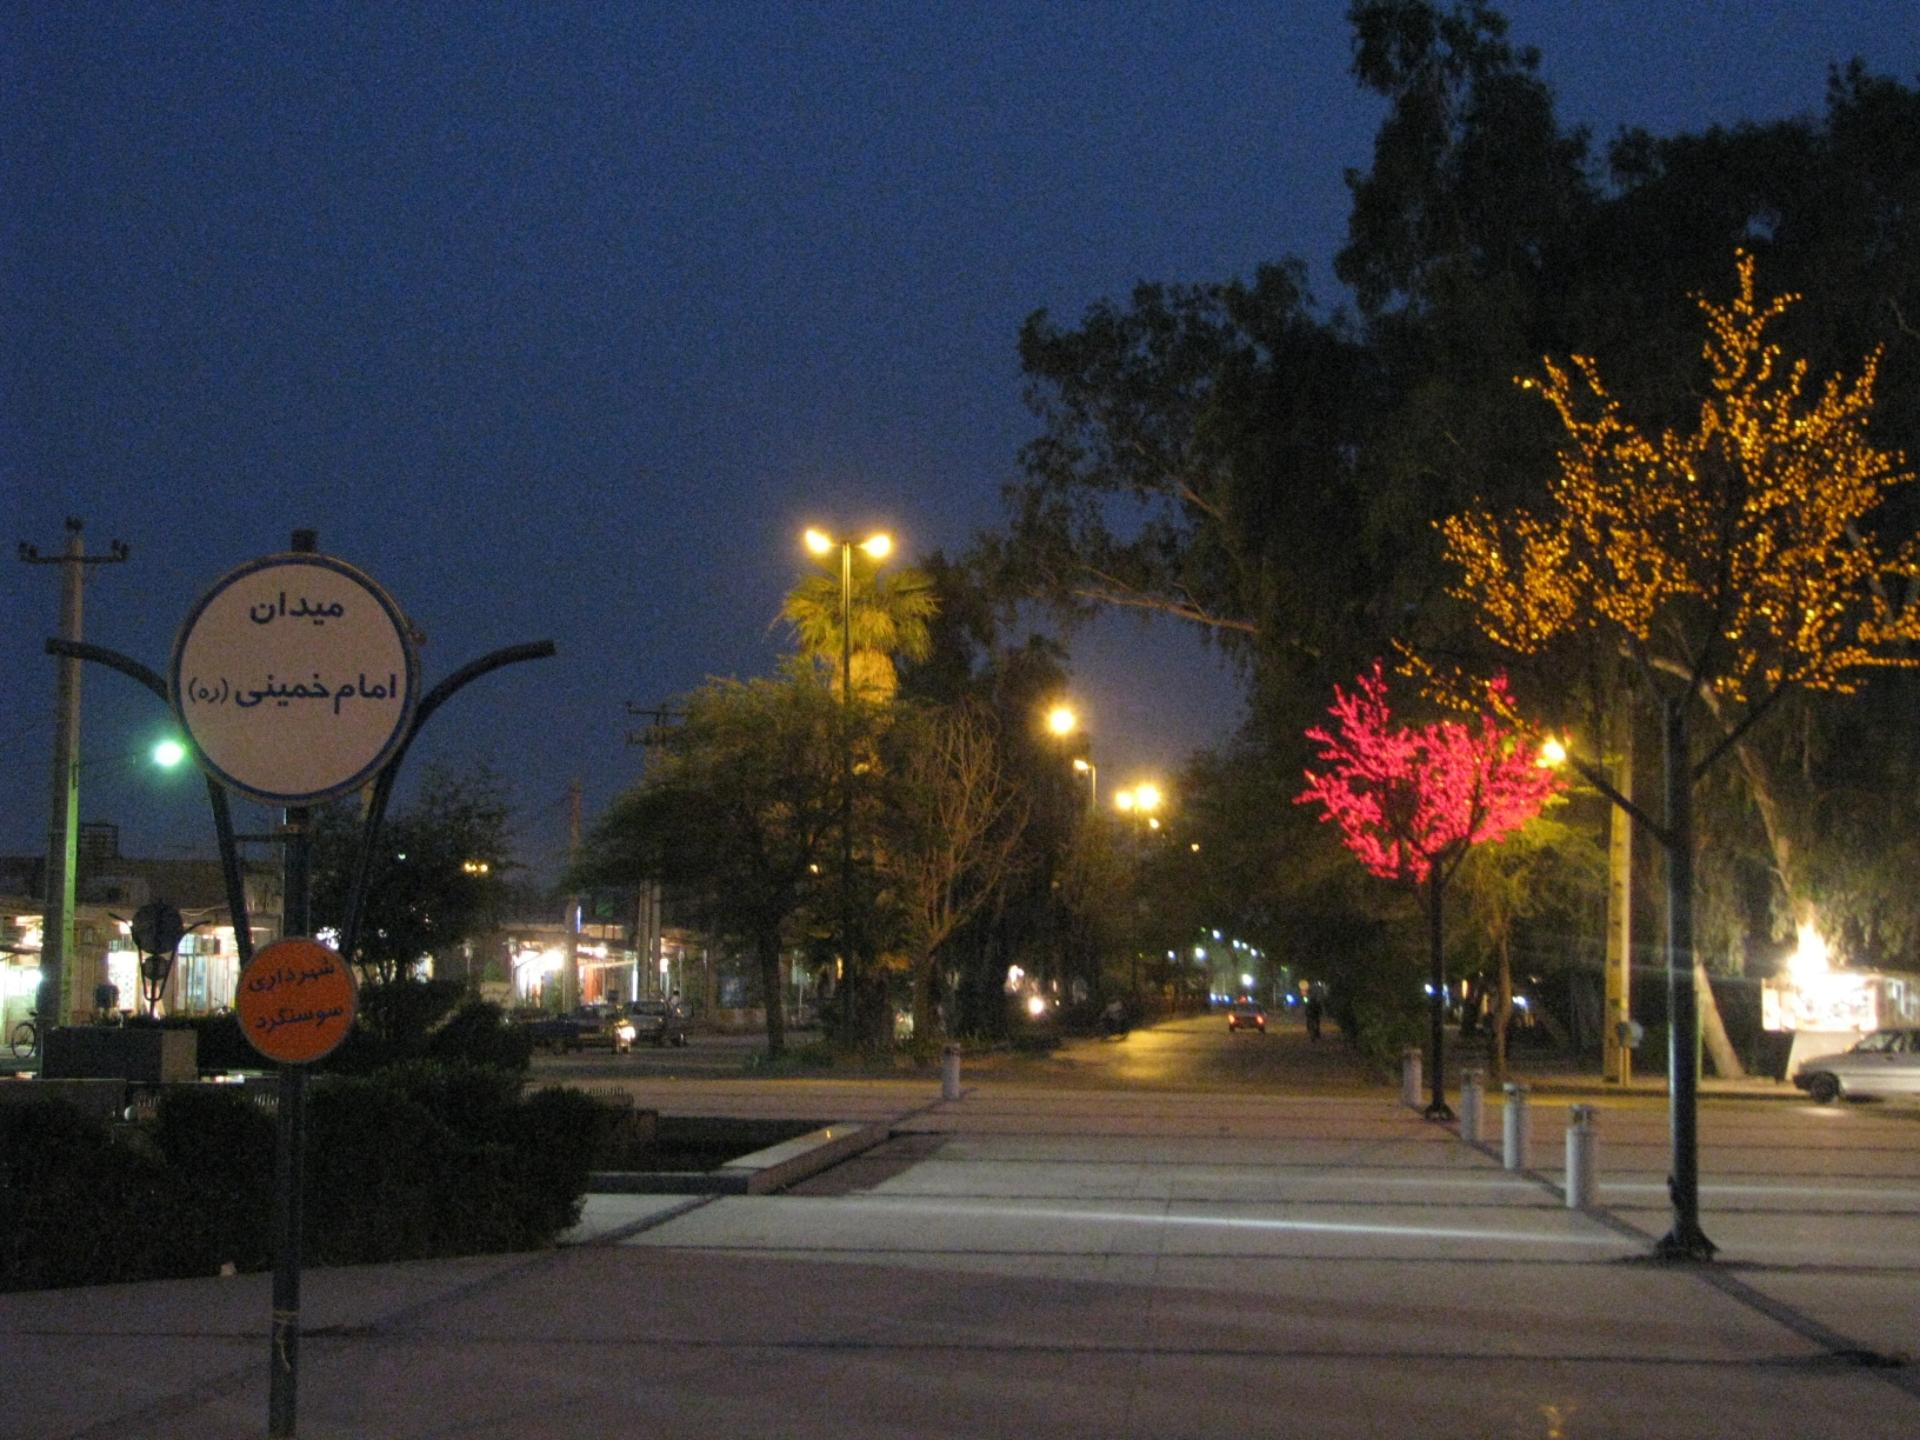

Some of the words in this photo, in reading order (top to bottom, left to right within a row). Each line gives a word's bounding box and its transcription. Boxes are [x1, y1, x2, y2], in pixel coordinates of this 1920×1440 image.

[250, 592, 344, 625] میدان
[235, 673, 330, 708] خمینی
[334, 672, 397, 715] امام
[248, 956, 336, 993] شهرداری
[255, 1006, 344, 1033] سوسنگرد
